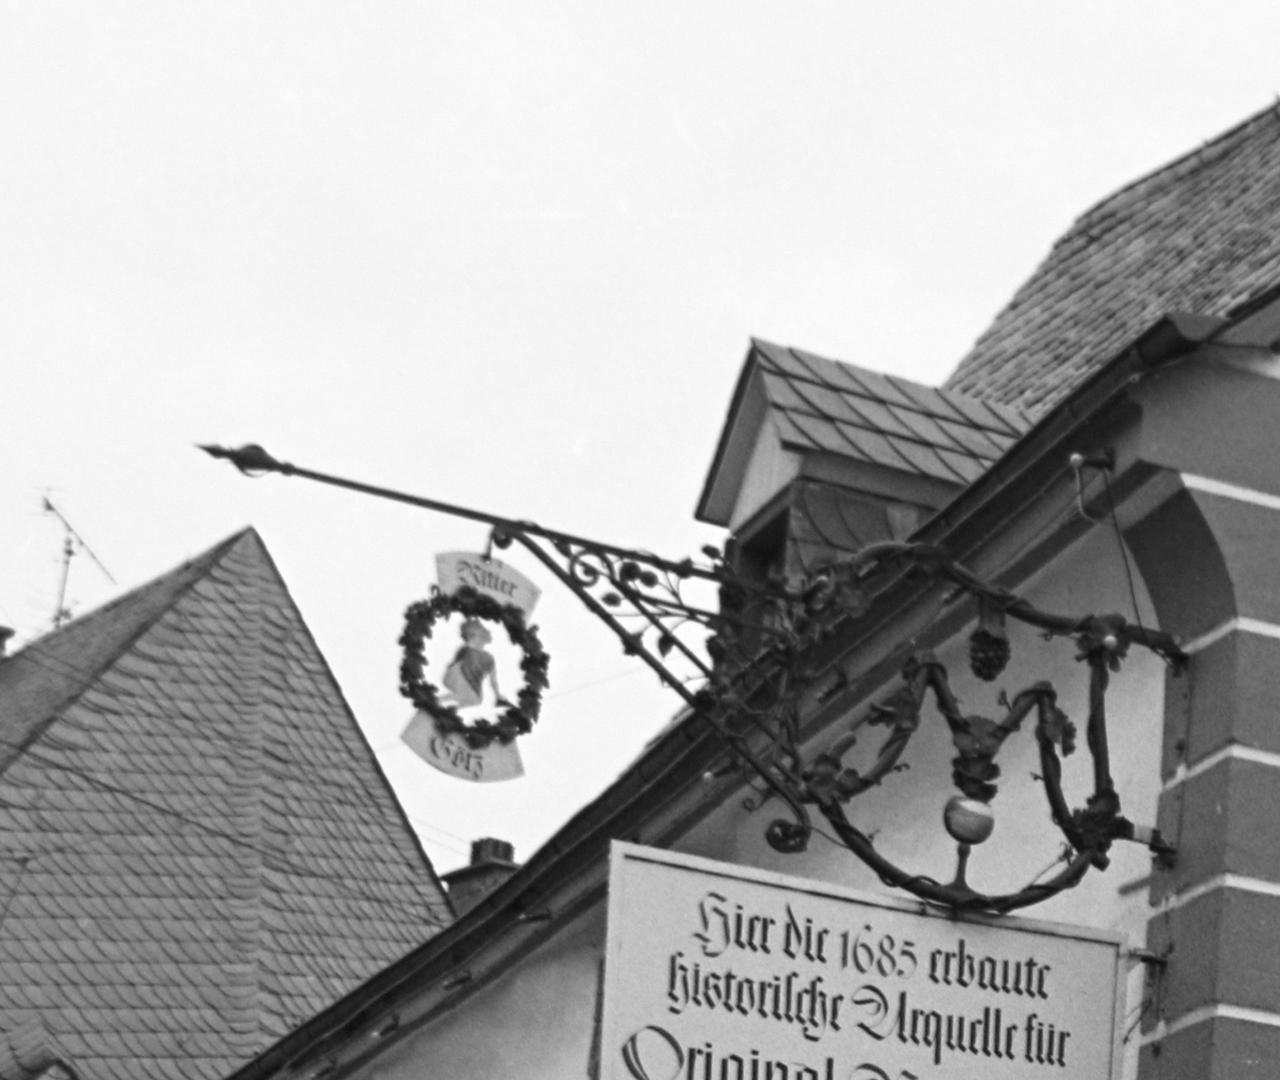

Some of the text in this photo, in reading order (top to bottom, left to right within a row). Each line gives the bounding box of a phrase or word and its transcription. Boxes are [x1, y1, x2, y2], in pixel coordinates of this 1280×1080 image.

[457, 560, 519, 598] Ritter
[694, 892, 1051, 1000] Hier die 1685 erbaute
[667, 952, 1072, 1067] historische Urquelle für
